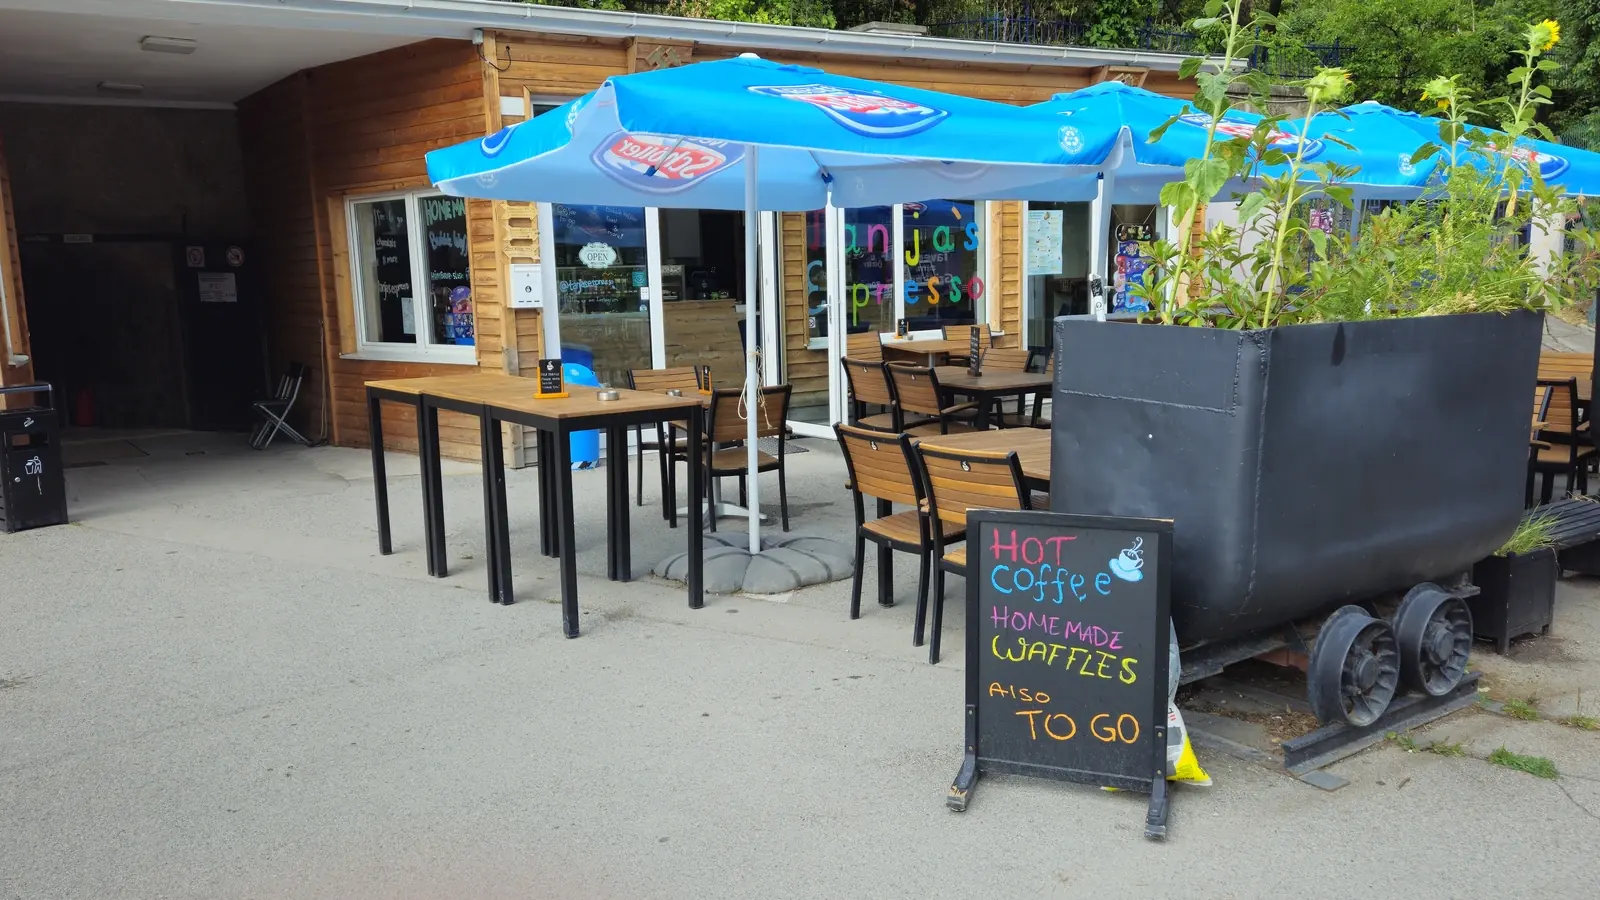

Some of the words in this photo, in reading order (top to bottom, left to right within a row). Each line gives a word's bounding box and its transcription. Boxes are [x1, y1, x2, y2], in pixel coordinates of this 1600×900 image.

[424, 198, 466, 225] HOMEMA
[587, 252, 608, 261] OPEN
[807, 259, 985, 327] Epresso
[990, 528, 1077, 565] HOT
[991, 564, 1111, 604] Coffee
[992, 634, 1138, 684] WAFFLES
[1016, 710, 1077, 740] TO
[1091, 713, 1140, 743] GO
